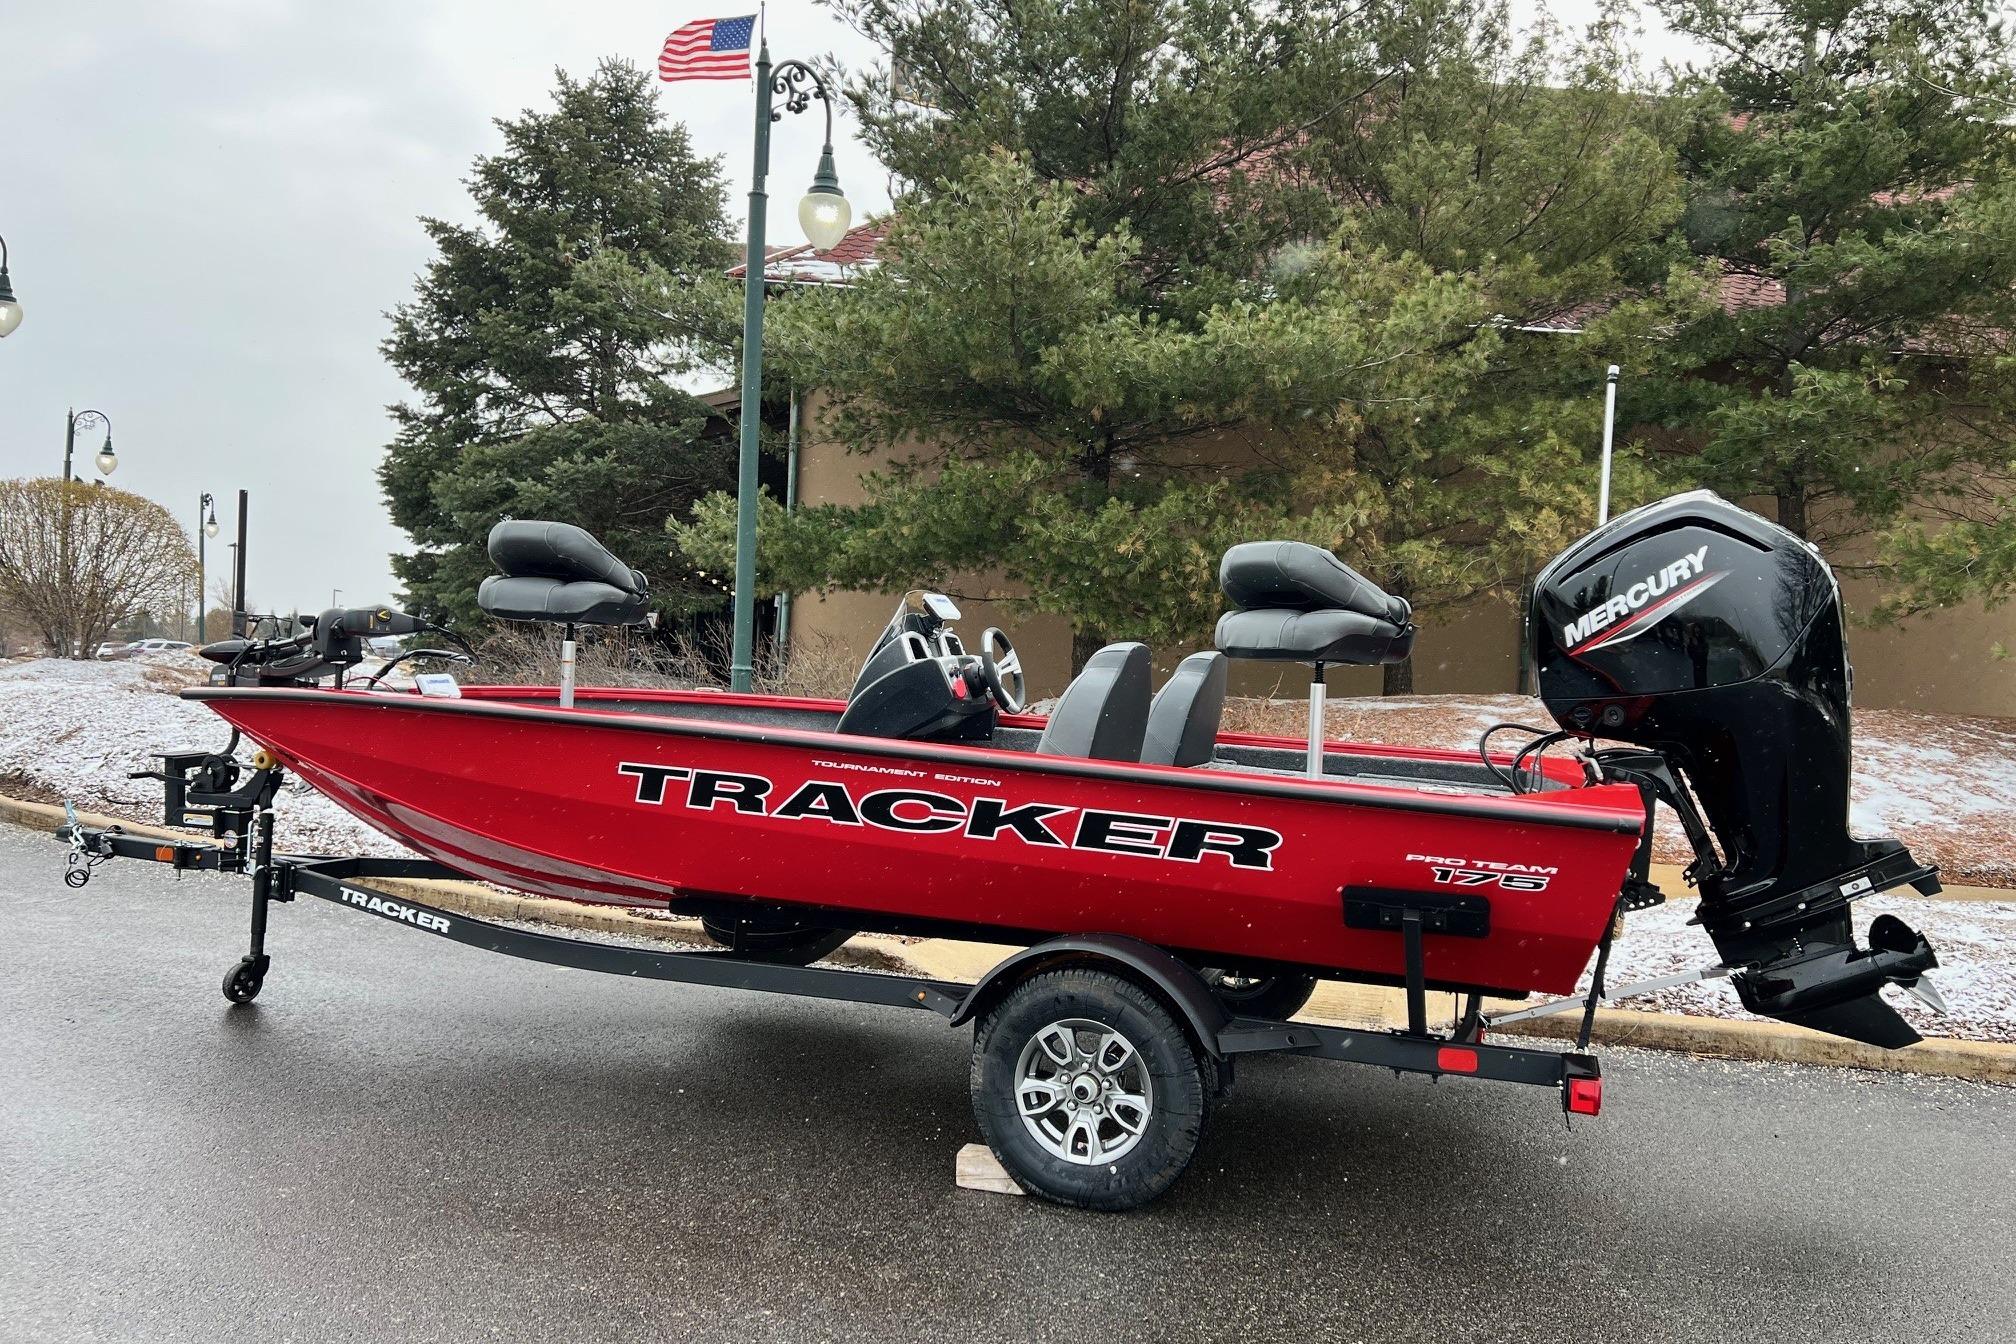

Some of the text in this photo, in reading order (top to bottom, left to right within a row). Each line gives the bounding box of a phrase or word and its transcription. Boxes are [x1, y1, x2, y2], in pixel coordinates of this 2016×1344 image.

[1563, 545, 1709, 648] MERCURY
[811, 759, 1002, 787] TOURNAMENT EDITION
[618, 761, 1284, 871] TRACKER
[1405, 853, 1559, 875] PRO TEAM
[1430, 866, 1551, 892] 175
[340, 886, 451, 934] TRACKER
